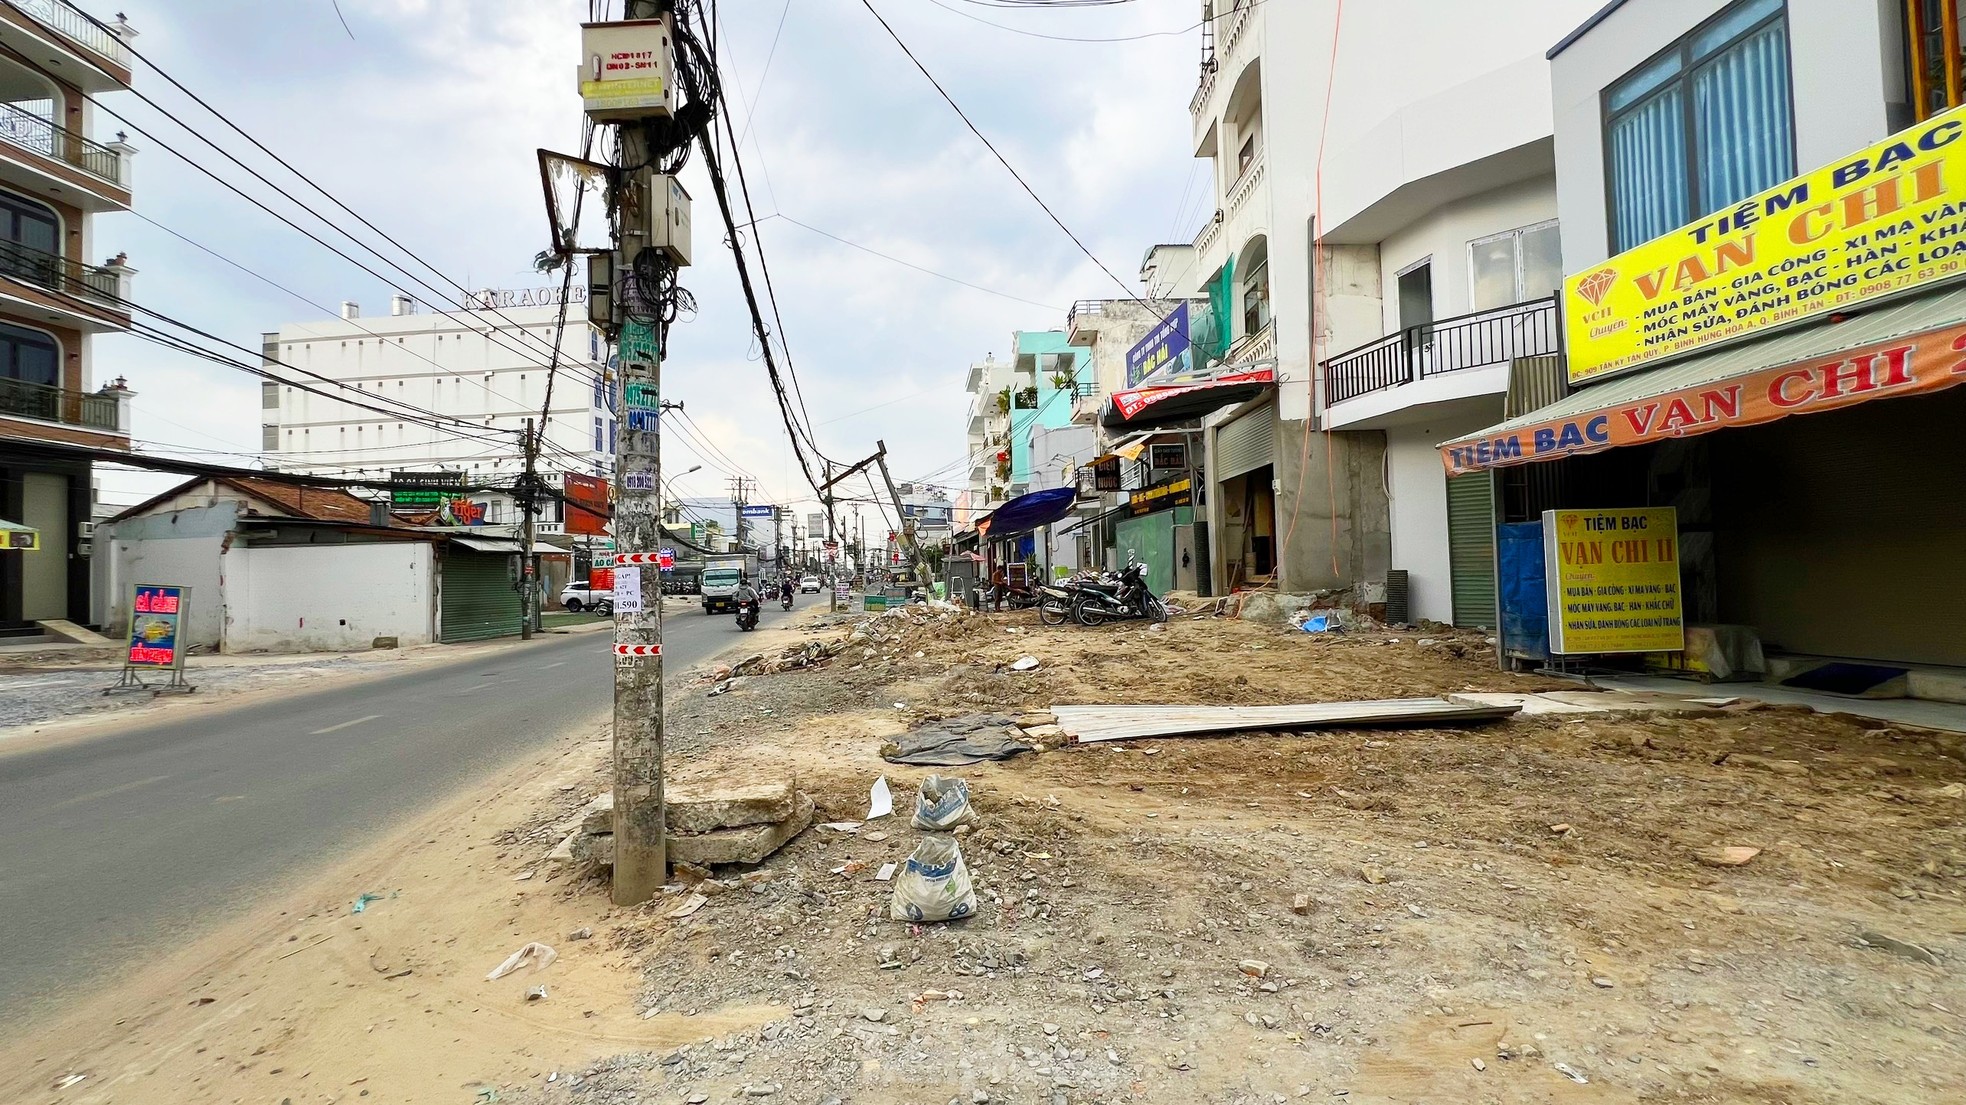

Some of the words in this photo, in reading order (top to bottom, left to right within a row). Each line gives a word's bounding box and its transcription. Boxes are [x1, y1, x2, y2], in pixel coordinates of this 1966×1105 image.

[1688, 182, 1809, 245] TIỆM
[1832, 120, 1963, 190] BẠC
[1633, 229, 1759, 302] VẠN
[1788, 157, 1948, 245] CHI
[1643, 300, 1679, 320] MUA
[1683, 285, 1718, 307] BÁN
[1731, 271, 1763, 290] GIA
[1767, 249, 1827, 277] CÔNG
[1844, 234, 1867, 252] XI
[1875, 219, 1915, 242] MẠ
[460, 284, 587, 311] KARAOKE
[1585, 366, 1598, 376] 909
[1859, 279, 1892, 297] 0908
[1897, 273, 1913, 285] 77
[1918, 267, 1935, 280] 63
[1940, 260, 1959, 273] 90
[1643, 315, 1678, 334] MÓC
[1682, 301, 1720, 323] MÁY
[1723, 283, 1782, 308] VÀNG,
[1786, 264, 1828, 288] BẠC
[1846, 242, 1898, 269] HÀN
[1644, 326, 1688, 347] NHẬN
[1692, 313, 1732, 333] SỬA,
[1736, 292, 1791, 319] ĐÁNH
[1796, 273, 1858, 301] BÓNG
[1864, 257, 1911, 280] CÁC
[1621, 384, 1742, 436] VẠN
[1766, 345, 1916, 408] CHI
[1450, 435, 1522, 468] TIỆM
[1534, 415, 1609, 455] BẠC
[453, 501, 482, 525] Tiger
[1560, 540, 1603, 569] VẠN
[1611, 539, 1649, 564] CHI
[1656, 538, 1674, 563] II
[1583, 513, 1617, 535] TIỆM
[1621, 515, 1648, 534] BẠC
[1566, 586, 1581, 597] MUA
[1596, 585, 1607, 596] GIA
